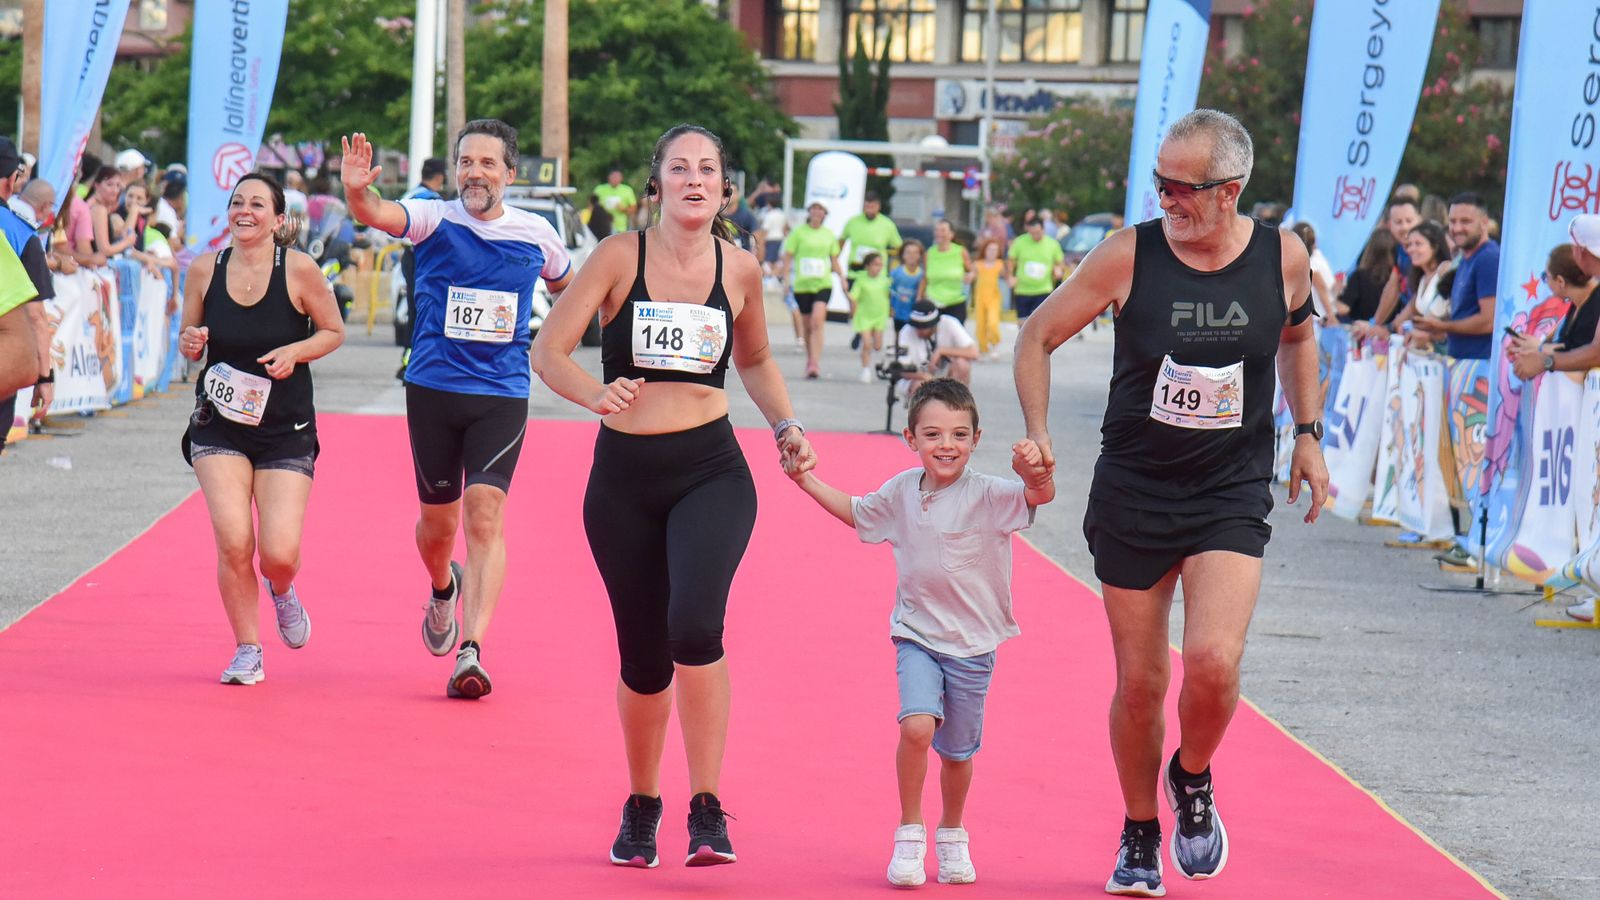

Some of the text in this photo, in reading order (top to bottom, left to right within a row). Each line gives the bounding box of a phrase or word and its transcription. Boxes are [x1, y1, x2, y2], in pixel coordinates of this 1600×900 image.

[1348, 0, 1391, 167] Sergey
[453, 305, 484, 326] 187
[638, 308, 655, 317] XXI
[1171, 301, 1249, 327] FILA
[641, 325, 684, 351] 148
[1164, 363, 1175, 378] XXI
[209, 378, 234, 403] 188
[1161, 383, 1201, 411] 149
